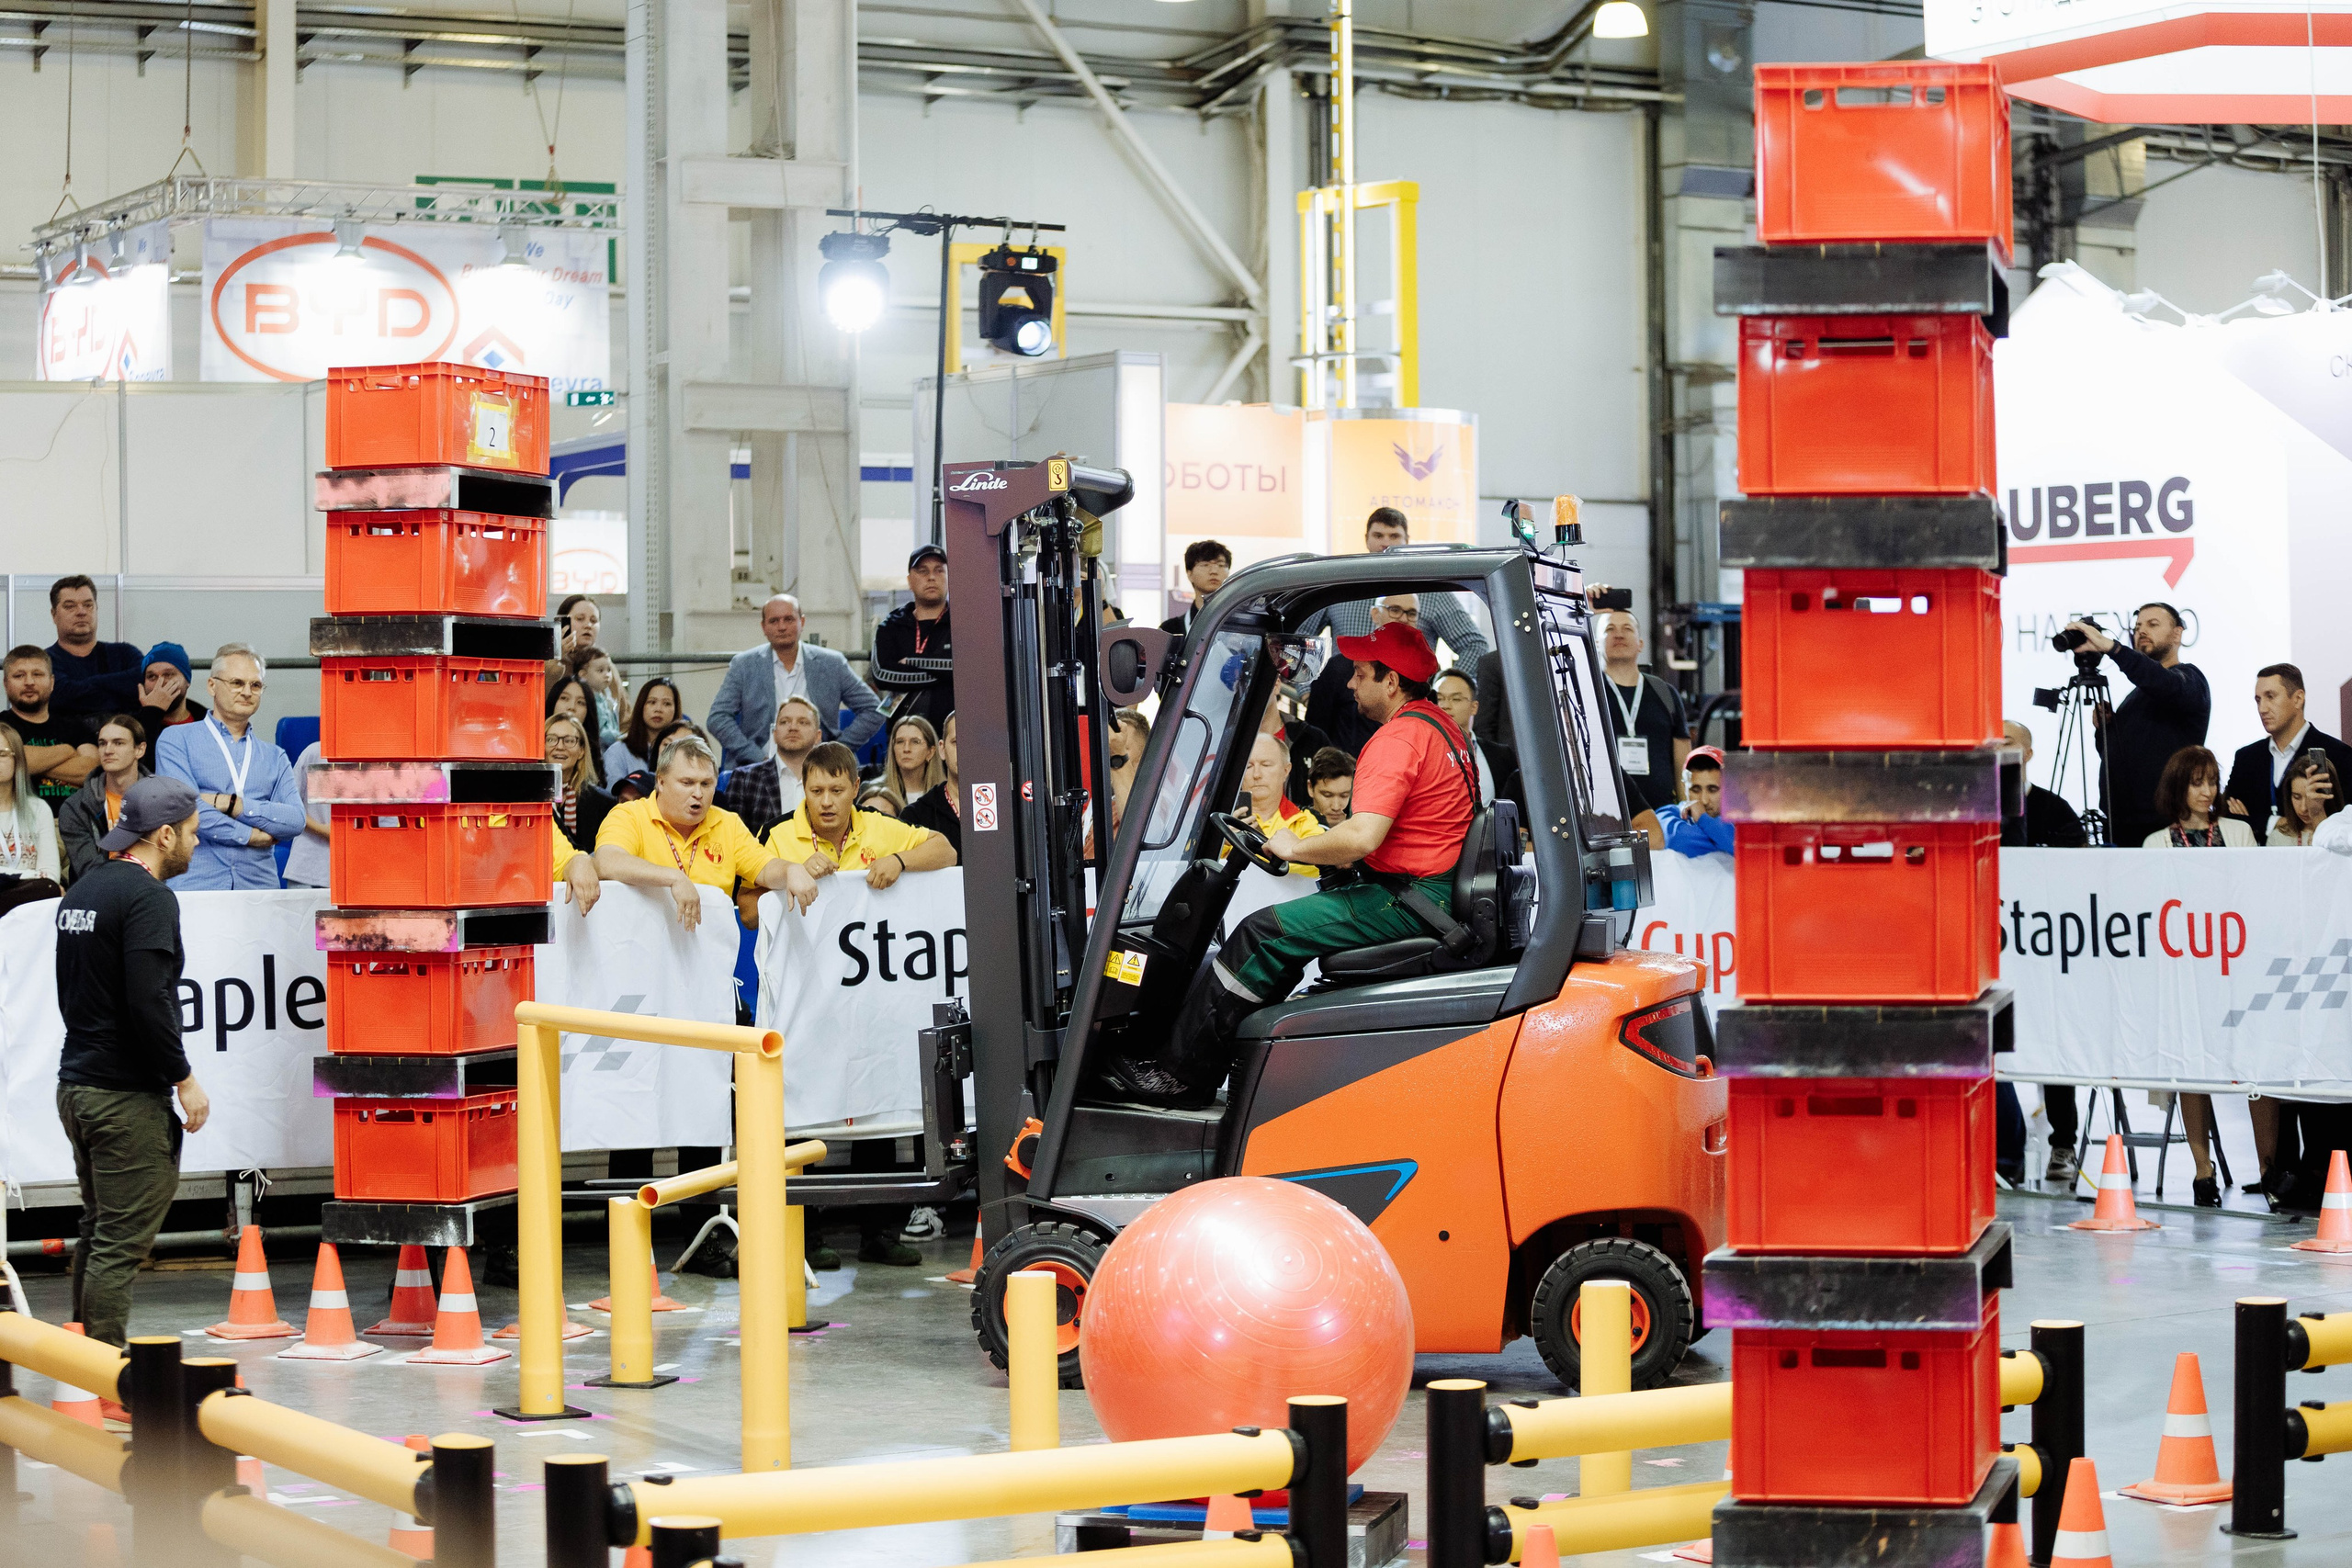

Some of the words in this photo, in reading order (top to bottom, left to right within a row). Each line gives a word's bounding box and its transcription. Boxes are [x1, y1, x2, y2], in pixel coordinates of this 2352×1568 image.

[552, 266, 604, 286] Dream
[245, 283, 431, 338] BYD
[489, 426, 497, 447] 2
[949, 471, 1008, 491] Linde
[2008, 476, 2194, 541] UBERG
[1998, 893, 2247, 976] taplerCup
